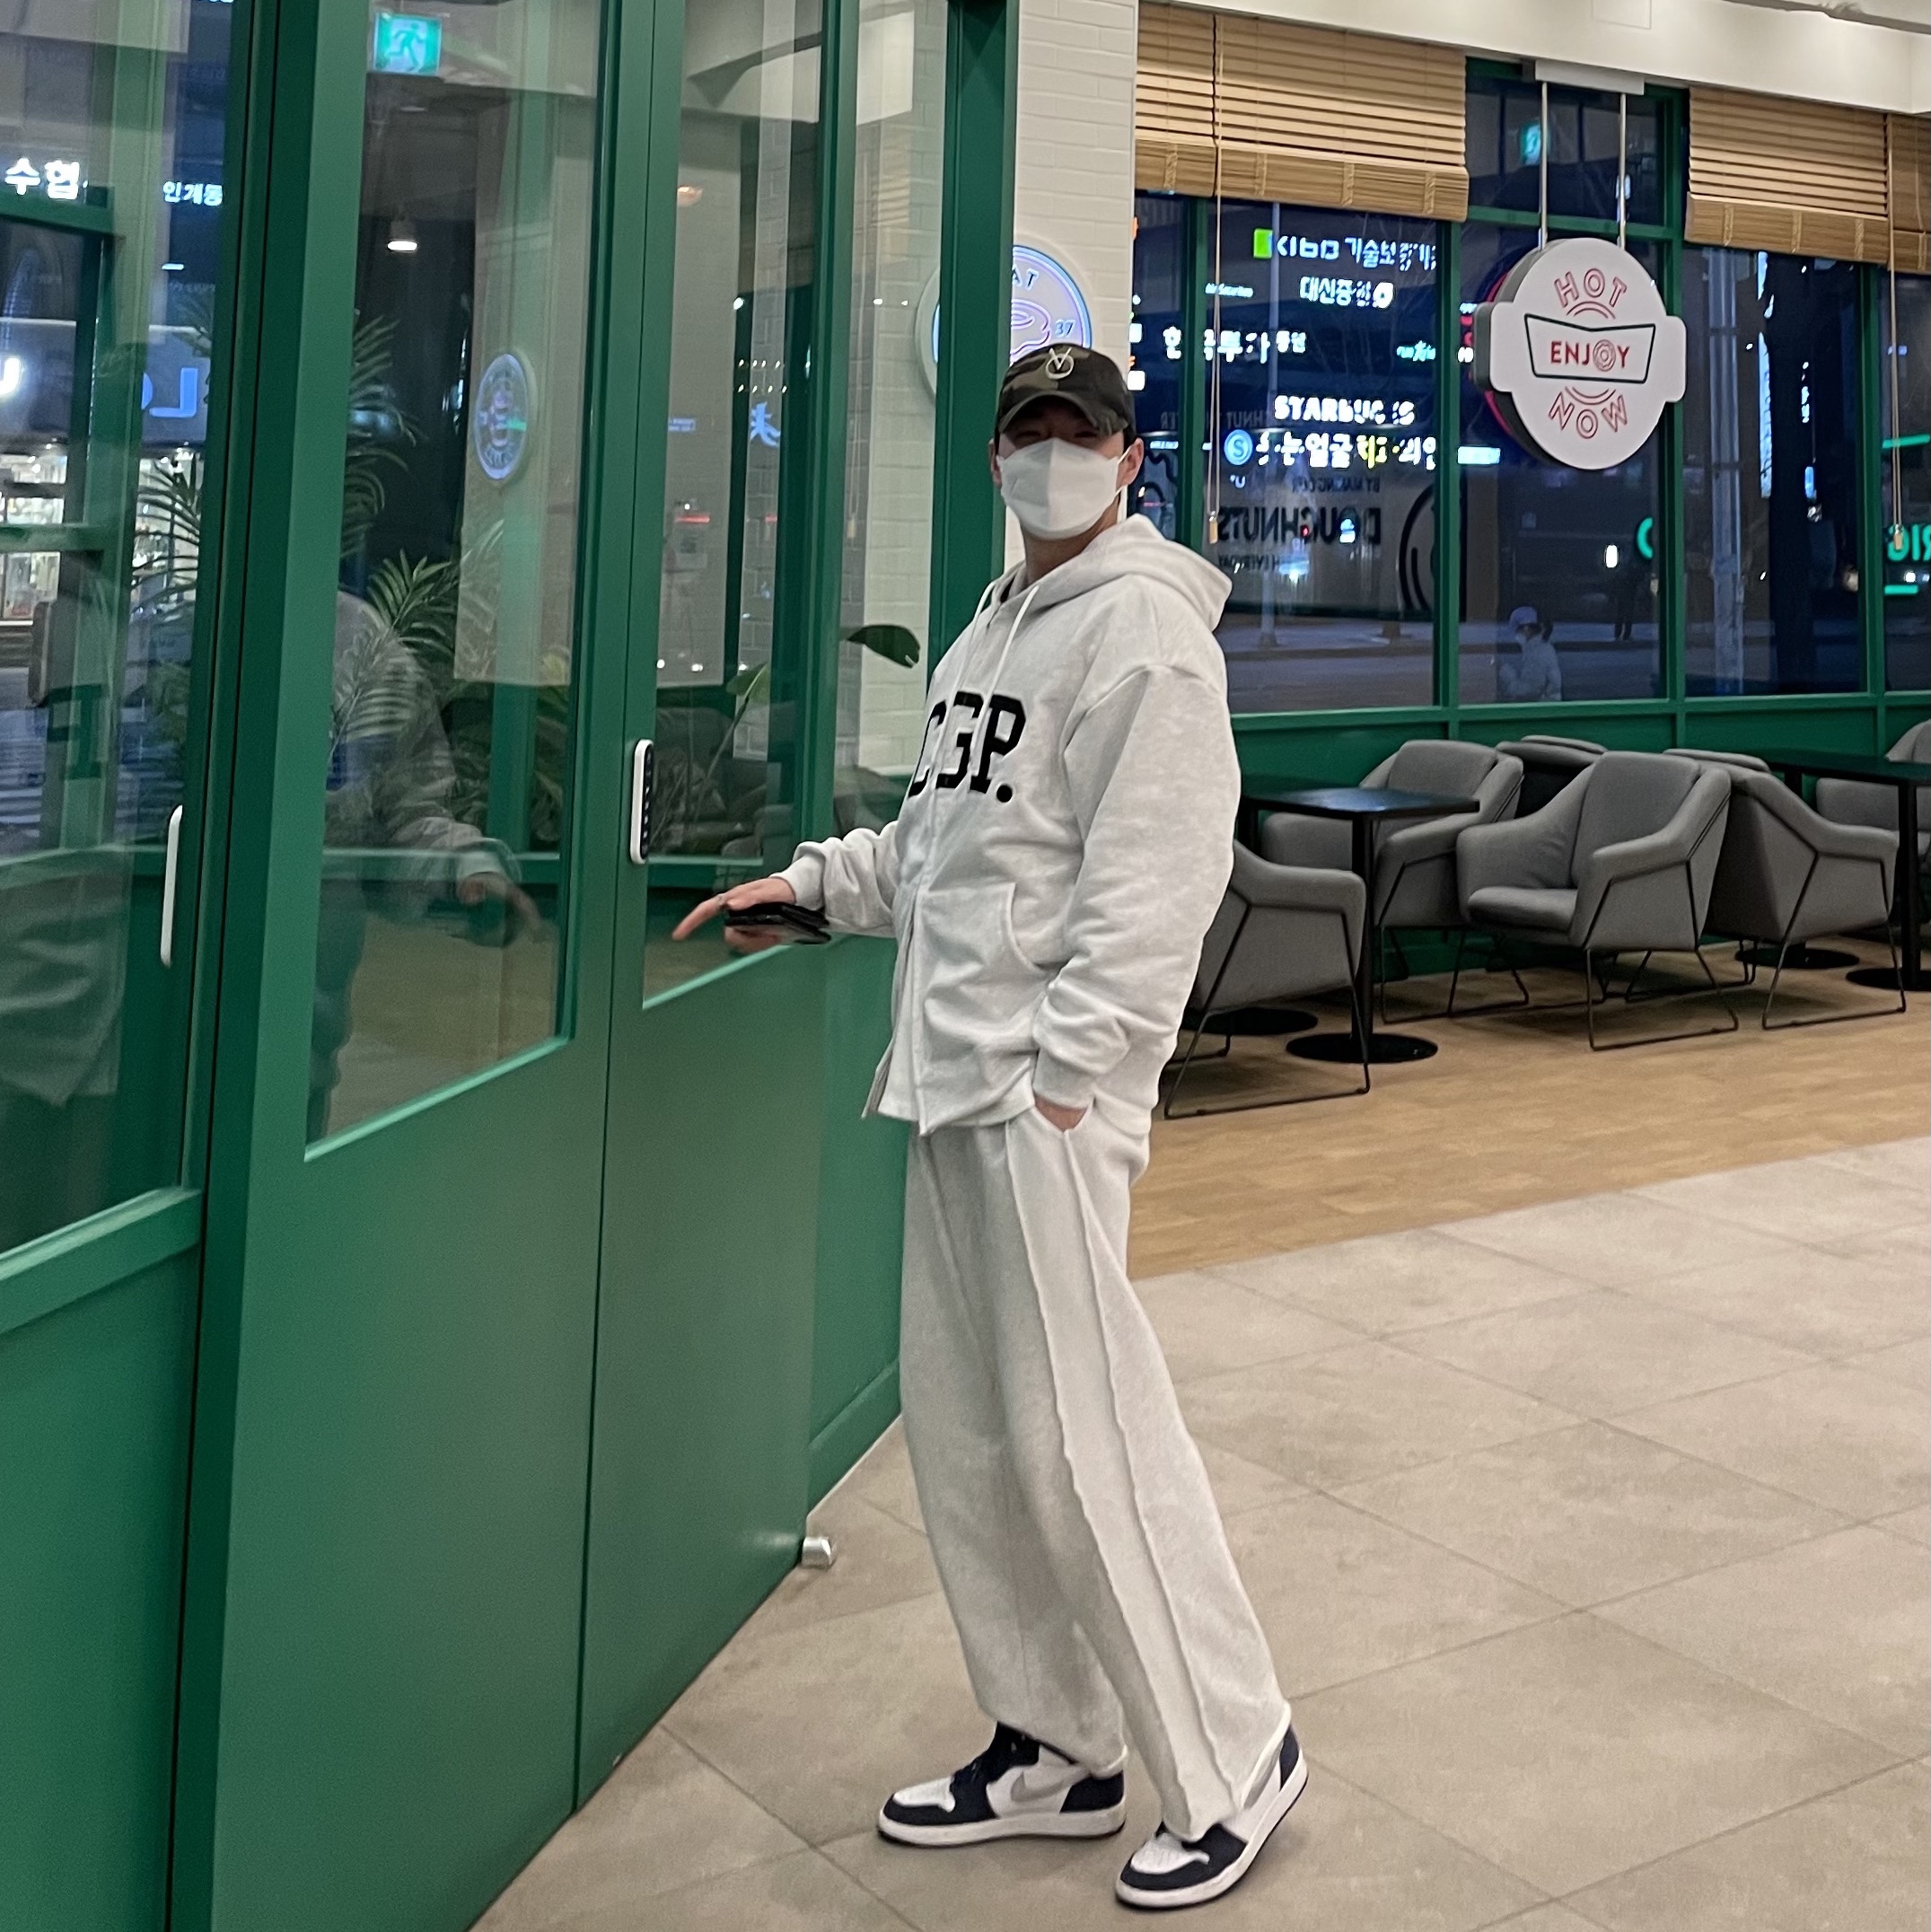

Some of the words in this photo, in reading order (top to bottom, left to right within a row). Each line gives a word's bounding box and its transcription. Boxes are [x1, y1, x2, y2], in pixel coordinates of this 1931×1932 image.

[1553, 268, 1628, 308] HOT
[1054, 319, 1076, 339] 37
[1550, 338, 1630, 373] ENJOY
[1548, 391, 1628, 440] NOW
